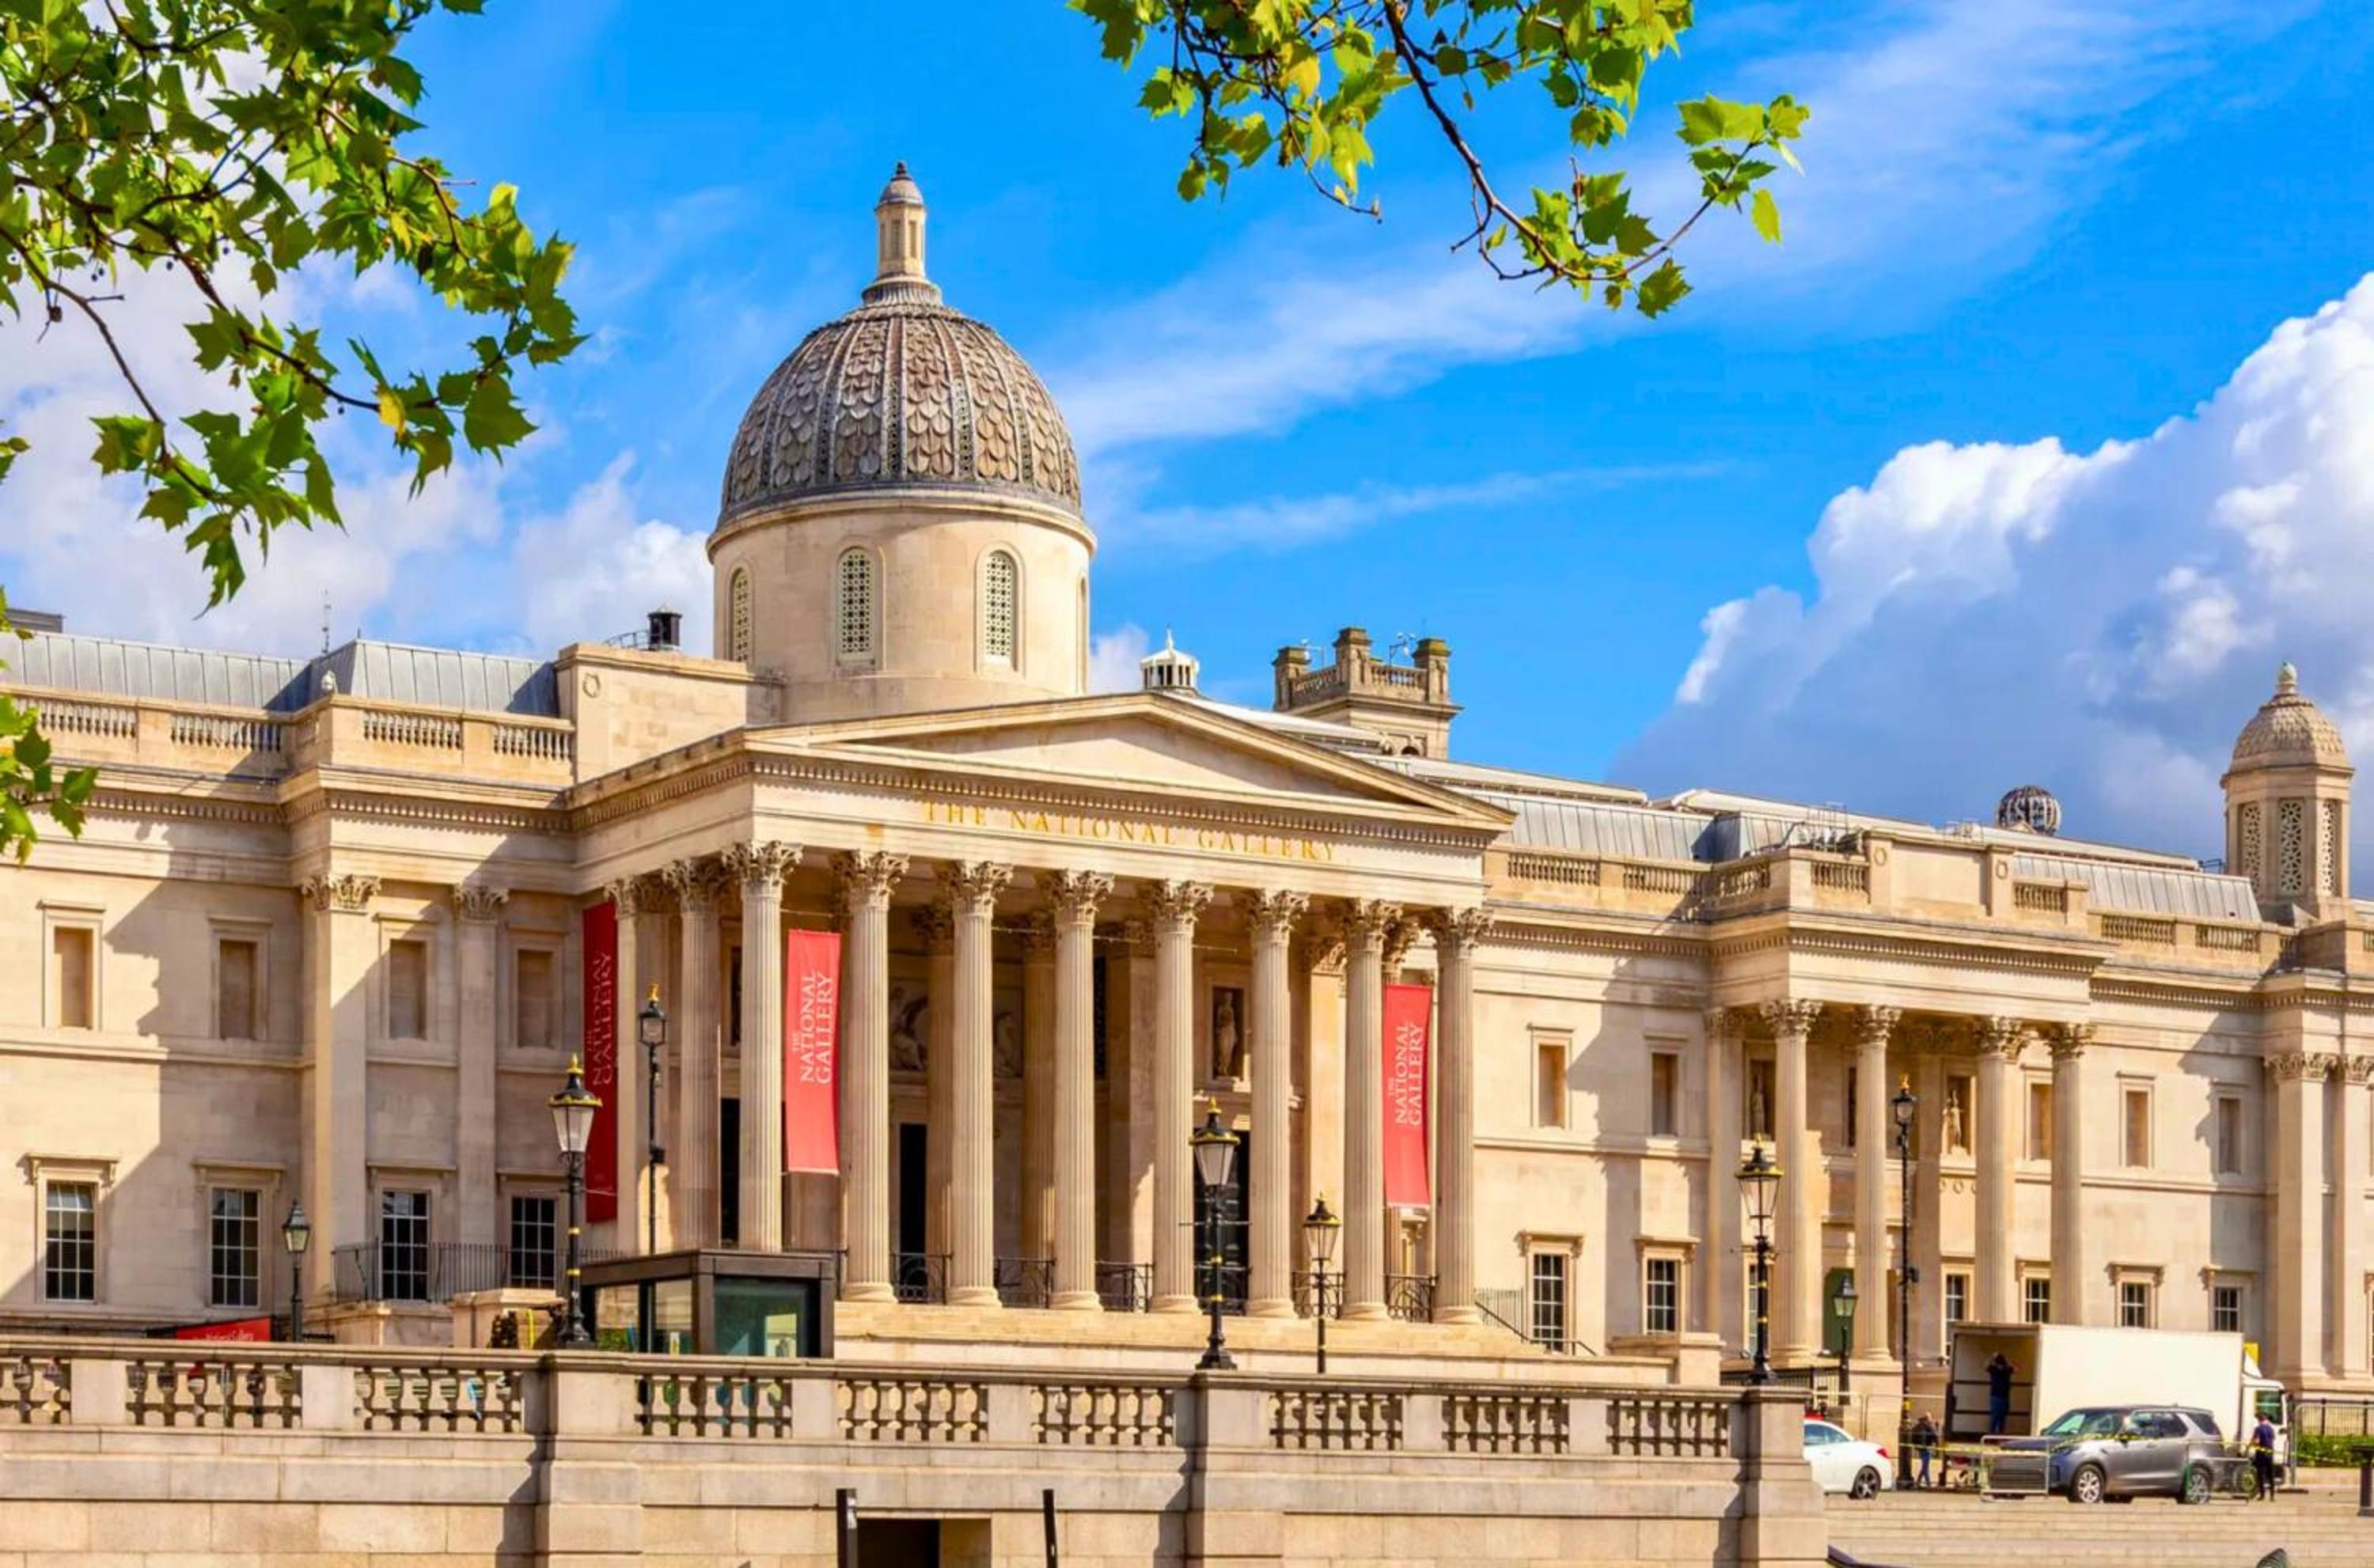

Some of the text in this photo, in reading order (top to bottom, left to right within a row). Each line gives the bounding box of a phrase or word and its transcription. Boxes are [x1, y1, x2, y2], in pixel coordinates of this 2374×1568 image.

[924, 800, 1336, 862] THE NATIONAL GALLERY
[593, 953, 602, 1085] NATIONAL
[601, 952, 612, 1085] GALLERY
[801, 968, 815, 1082] NATIONAL
[815, 970, 833, 1085] GALLERY
[1395, 1022, 1409, 1125] NATIONAL
[1408, 1021, 1424, 1127] GALLERY
